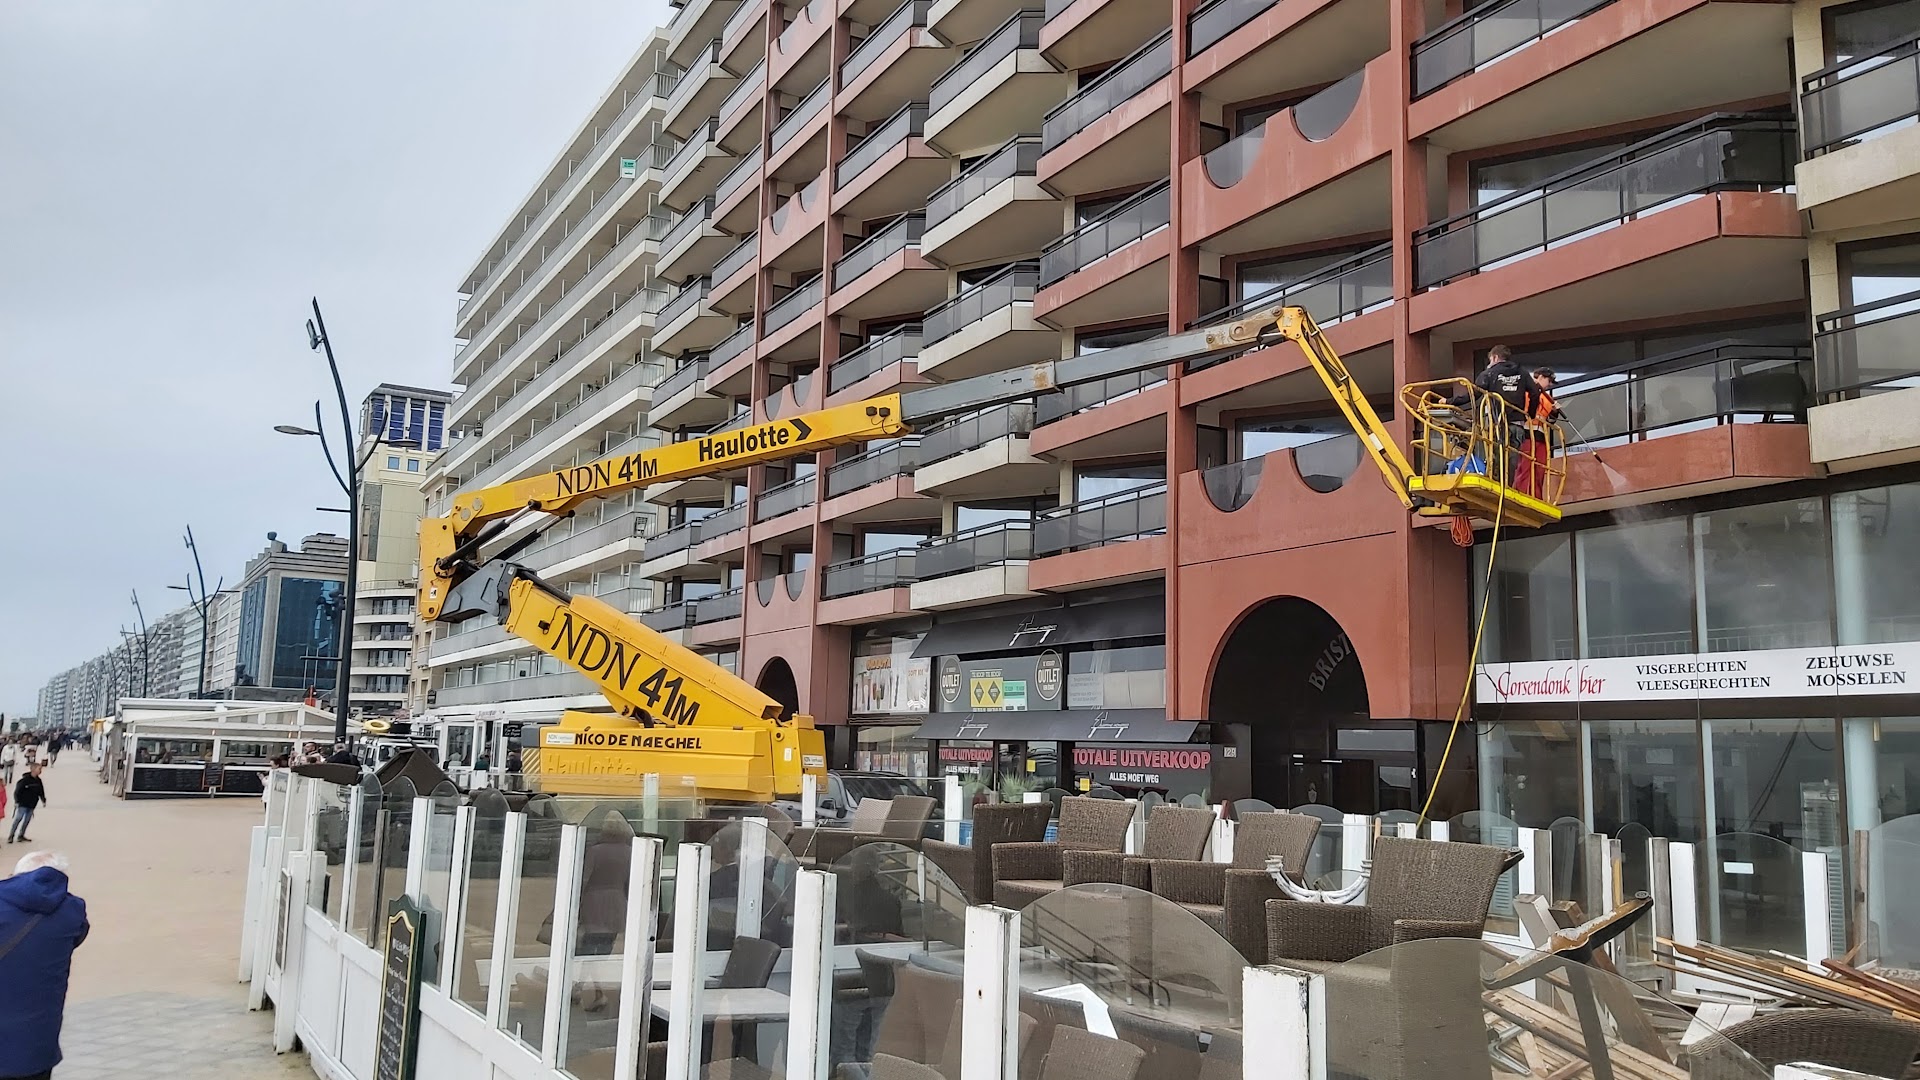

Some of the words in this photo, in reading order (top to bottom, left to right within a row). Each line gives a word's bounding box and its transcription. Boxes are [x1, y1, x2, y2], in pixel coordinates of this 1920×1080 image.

[699, 425, 790, 462] Haulotte
[555, 460, 611, 497] NDN
[618, 453, 658, 481] 41M
[550, 612, 641, 690] NDN
[638, 668, 700, 726] 41M
[1636, 660, 1747, 675] VISGERECHTEN
[1805, 653, 1895, 670] ZEEUWSE
[942, 674, 960, 688] OUTLET
[1037, 668, 1060, 684] OUTLET
[1497, 666, 1573, 697] Corsendonk
[1579, 665, 1606, 695] bier
[1636, 676, 1771, 691] VLEESGERECHTEN
[1807, 670, 1906, 687] MOSSELEN
[608, 733, 629, 746] DE
[631, 735, 702, 749] NAEGHEL
[939, 748, 958, 760] TOTALE
[1072, 748, 1117, 766] TOTALE
[1120, 750, 1211, 770] UITVERKOOP
[1109, 772, 1127, 782] ALLES
[1127, 773, 1144, 783] MOET
[1144, 774, 1160, 784] WEG
